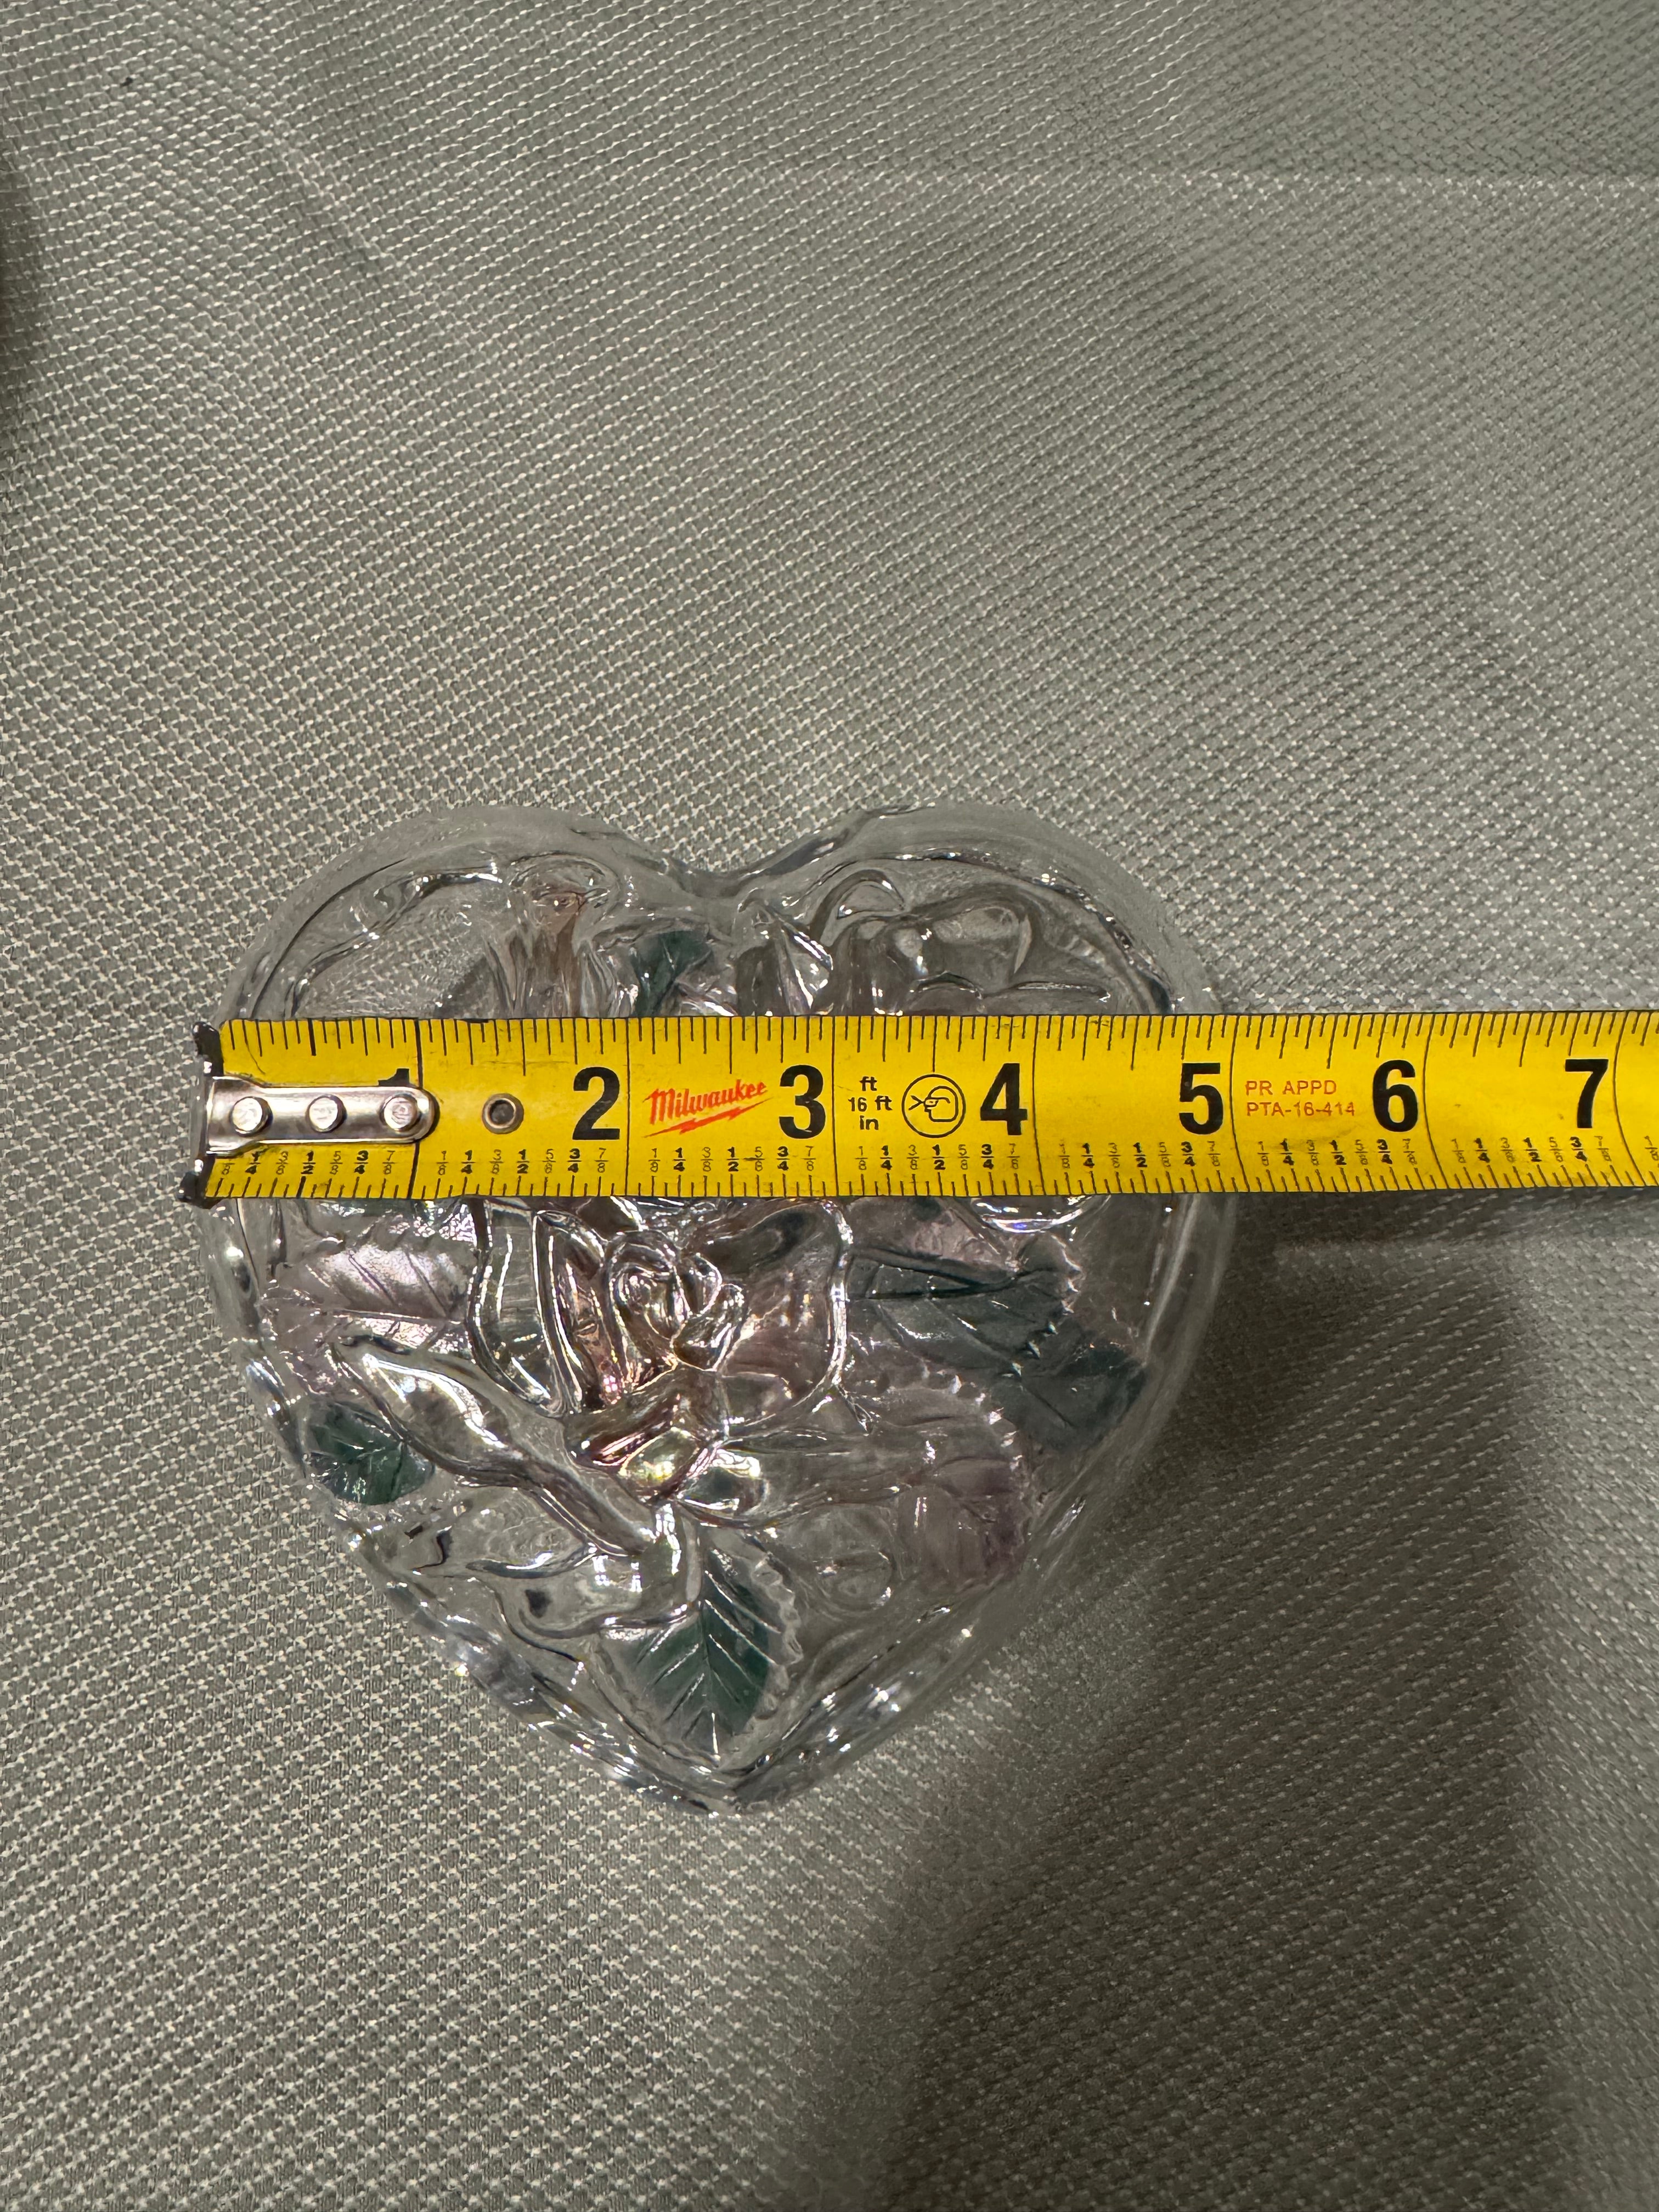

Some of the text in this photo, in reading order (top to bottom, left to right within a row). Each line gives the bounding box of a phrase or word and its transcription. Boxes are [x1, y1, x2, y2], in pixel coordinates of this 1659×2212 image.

[572, 1066, 620, 1141] 2
[642, 1079, 768, 1125] Milwaukee
[779, 1064, 826, 1139] 3
[848, 1096, 892, 1112] 16 ft
[860, 1076, 877, 1092] ft
[980, 1063, 1028, 1135] 4
[1179, 1063, 1223, 1135] 5
[1245, 1080, 1336, 1096] PR APPD
[1246, 1102, 1355, 1117] PTA-16-414
[1373, 1060, 1418, 1132] 6
[1565, 1059, 1609, 1128] 7
[860, 1115, 879, 1130] in
